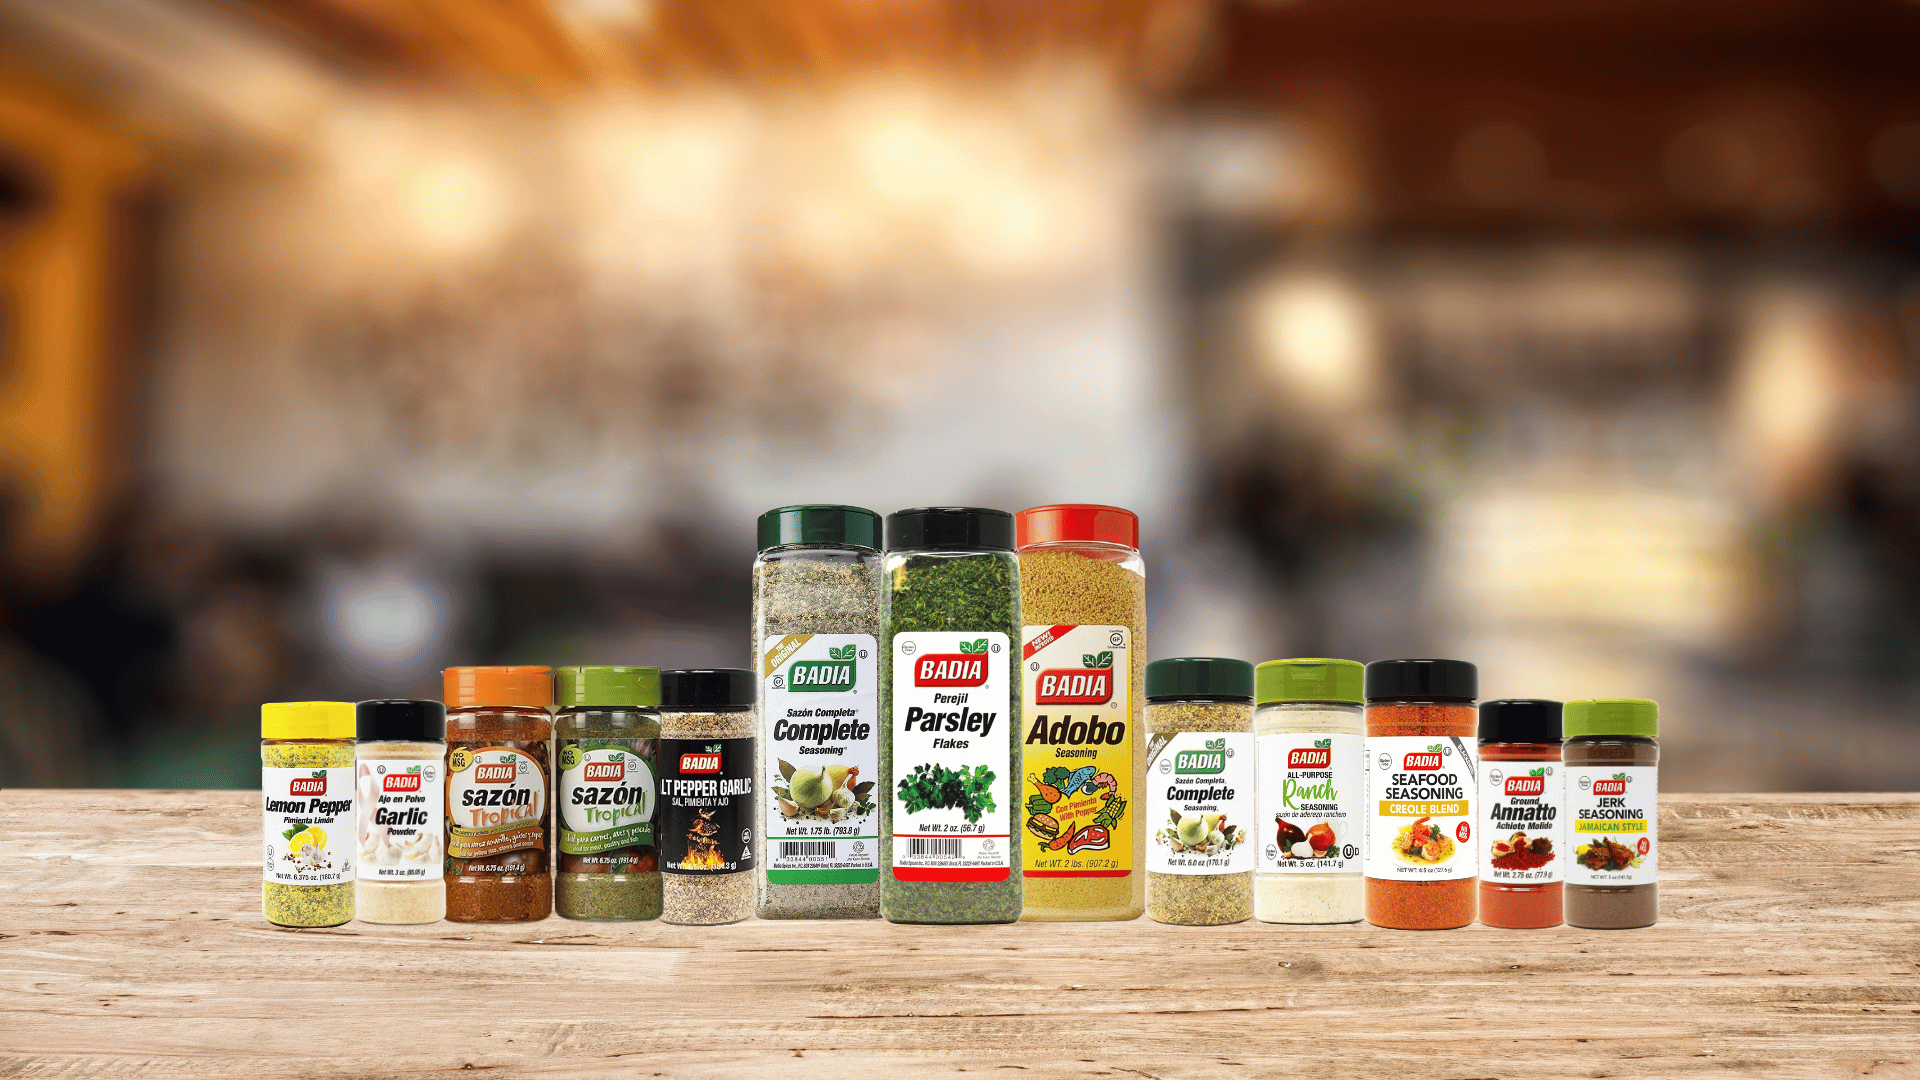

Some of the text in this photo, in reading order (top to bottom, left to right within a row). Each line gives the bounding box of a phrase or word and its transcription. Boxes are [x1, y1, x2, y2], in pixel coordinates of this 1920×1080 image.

[1032, 631, 1051, 646] NEW!
[771, 638, 802, 668] ORIGINAL
[793, 666, 850, 685] BADIA
[920, 661, 982, 680] BADIA
[1041, 676, 1106, 696] BADIA
[934, 693, 968, 705] Perejil
[787, 708, 855, 718] Sazón Completa
[904, 707, 997, 737] Parsley
[774, 719, 870, 745] Complete
[1025, 715, 1125, 745] Adobo
[933, 738, 969, 749] Flakes
[799, 746, 844, 756] Seasoning
[1056, 748, 1097, 759] Seasoning
[453, 758, 465, 767] MSG
[682, 757, 718, 770] BADIA
[1178, 754, 1221, 769] BADIA
[1291, 752, 1327, 764] BADIA
[1406, 756, 1439, 766] BADIA
[477, 767, 512, 779] BADIA
[586, 766, 621, 777] BADIA
[386, 777, 417, 788] BADIA
[1392, 774, 1458, 786] SEAFOOD
[1507, 780, 1541, 791] BADIA
[293, 782, 323, 792] BADIA
[572, 781, 642, 805] sazón
[661, 778, 751, 796] LT PEPPER GARLIC
[1596, 782, 1622, 792] BADIA
[378, 795, 391, 804] Ajo
[462, 783, 530, 806] sazón
[1167, 786, 1234, 803] Complete
[1283, 779, 1338, 810] Ranch
[1386, 788, 1463, 800] SEASONING
[266, 796, 352, 816] Lemon Pepper
[672, 797, 683, 807] SAL,
[713, 798, 717, 806] Y
[718, 797, 729, 806] AJO
[1056, 797, 1097, 814] Con Pimienta
[1597, 798, 1626, 807] JERK
[470, 791, 538, 826] Tropical
[584, 792, 645, 826] Tropical
[1060, 806, 1097, 821] With Pepper
[1390, 804, 1459, 814] CREOLE BLEND
[1490, 803, 1556, 821] Annatto
[1579, 809, 1643, 819] SEASONING
[375, 807, 428, 825] Garlic
[786, 827, 797, 835] Net
[833, 827, 852, 836] (793.8
[854, 827, 860, 836] g)
[961, 824, 977, 833] (56.7
[978, 824, 985, 834] g)
[1579, 823, 1619, 831] JAMAICAN
[666, 861, 676, 869] Net
[1086, 860, 1110, 868] (907.2
[1111, 860, 1118, 869] g)
